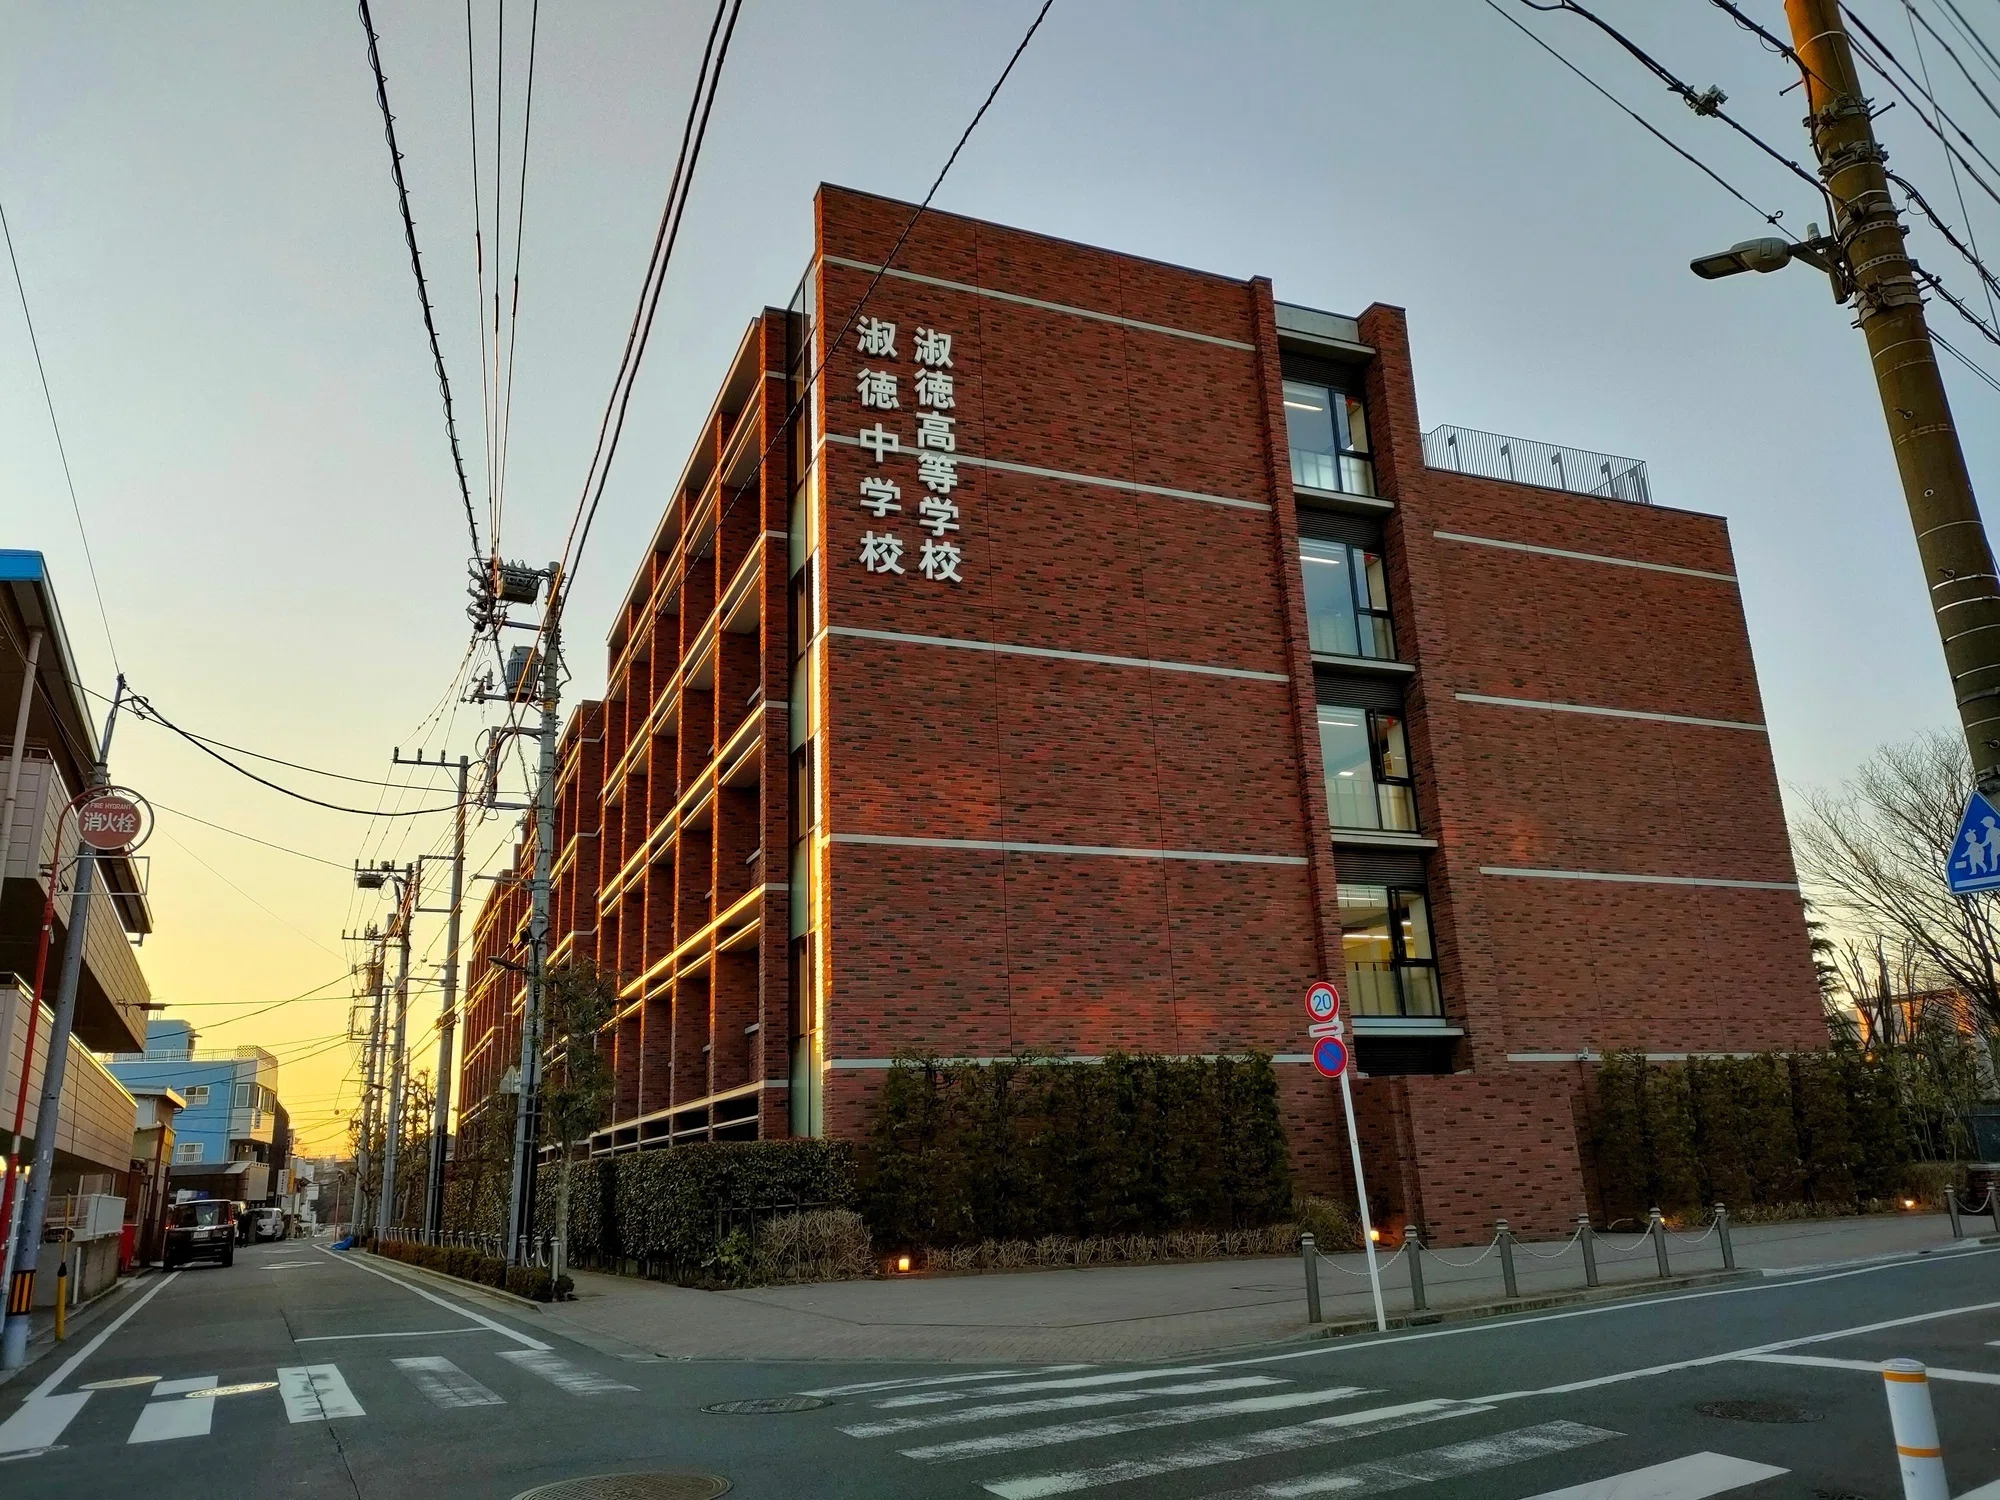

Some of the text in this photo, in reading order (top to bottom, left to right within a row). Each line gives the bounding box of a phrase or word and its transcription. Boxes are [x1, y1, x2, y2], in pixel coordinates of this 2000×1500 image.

[856, 315, 906, 575] 淑徳中学校
[913, 326, 963, 583] 淑徳高等学校
[83, 811, 137, 833] 消火栓
[1313, 993, 1332, 1012] 20
